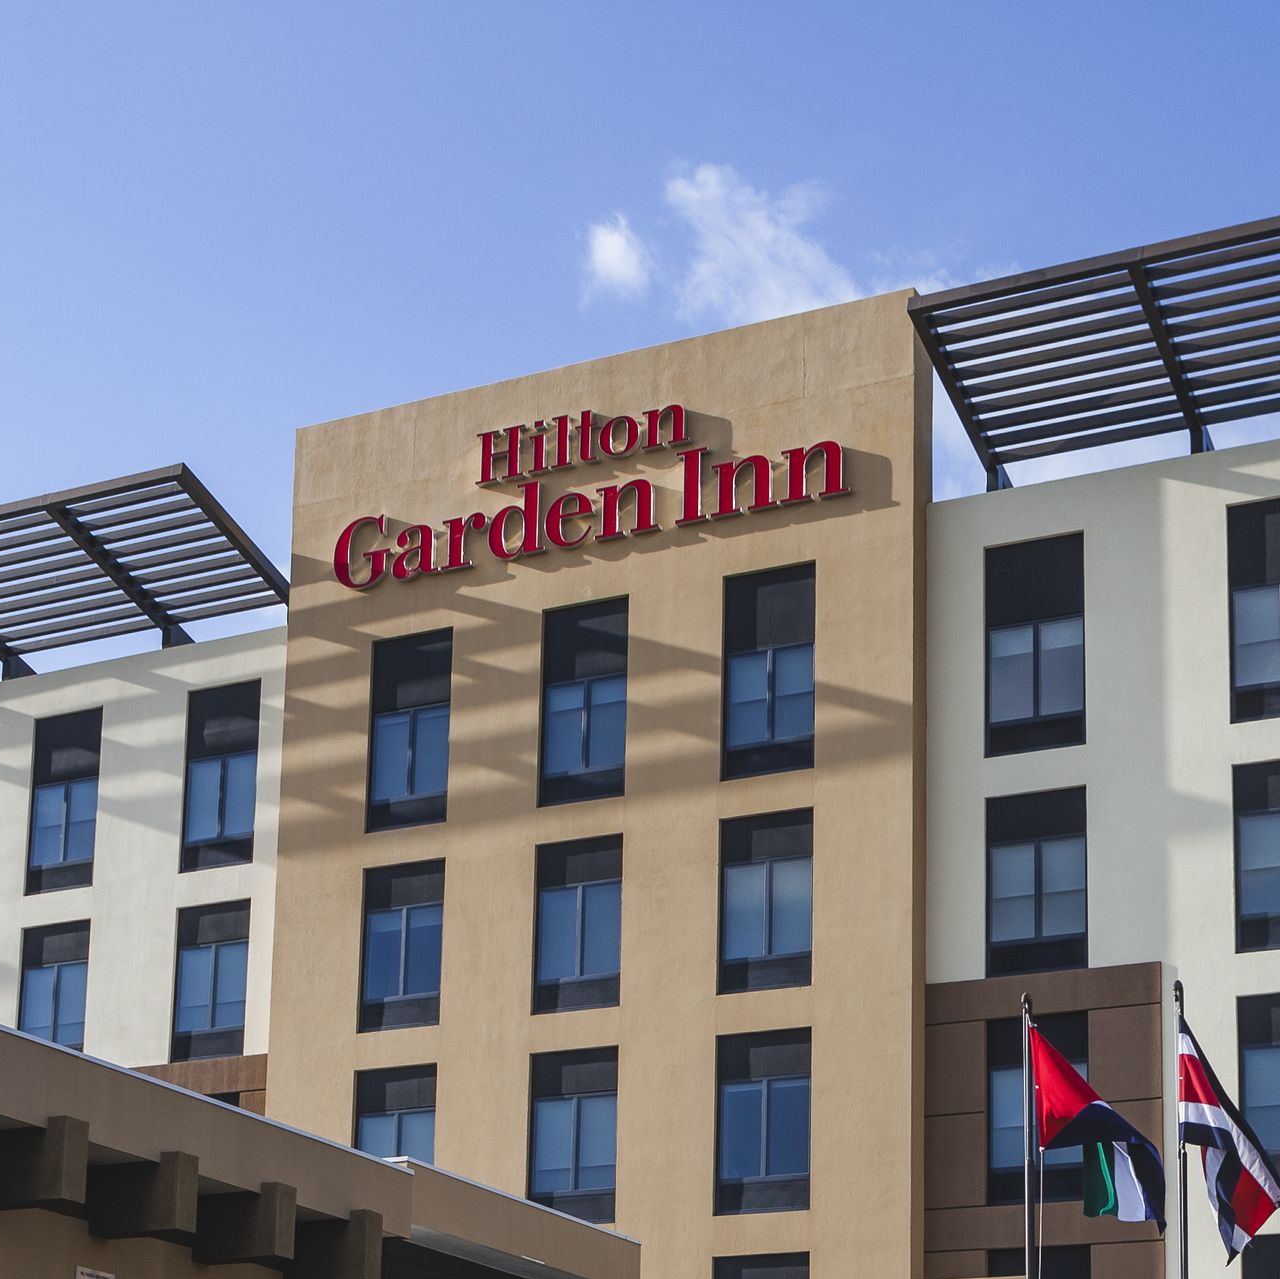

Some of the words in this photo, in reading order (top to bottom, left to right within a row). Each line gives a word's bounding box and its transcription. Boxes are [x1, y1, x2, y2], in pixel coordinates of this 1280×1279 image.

[475, 404, 694, 487] Hilton
[333, 483, 659, 590] Garden
[675, 440, 852, 527] Inn
